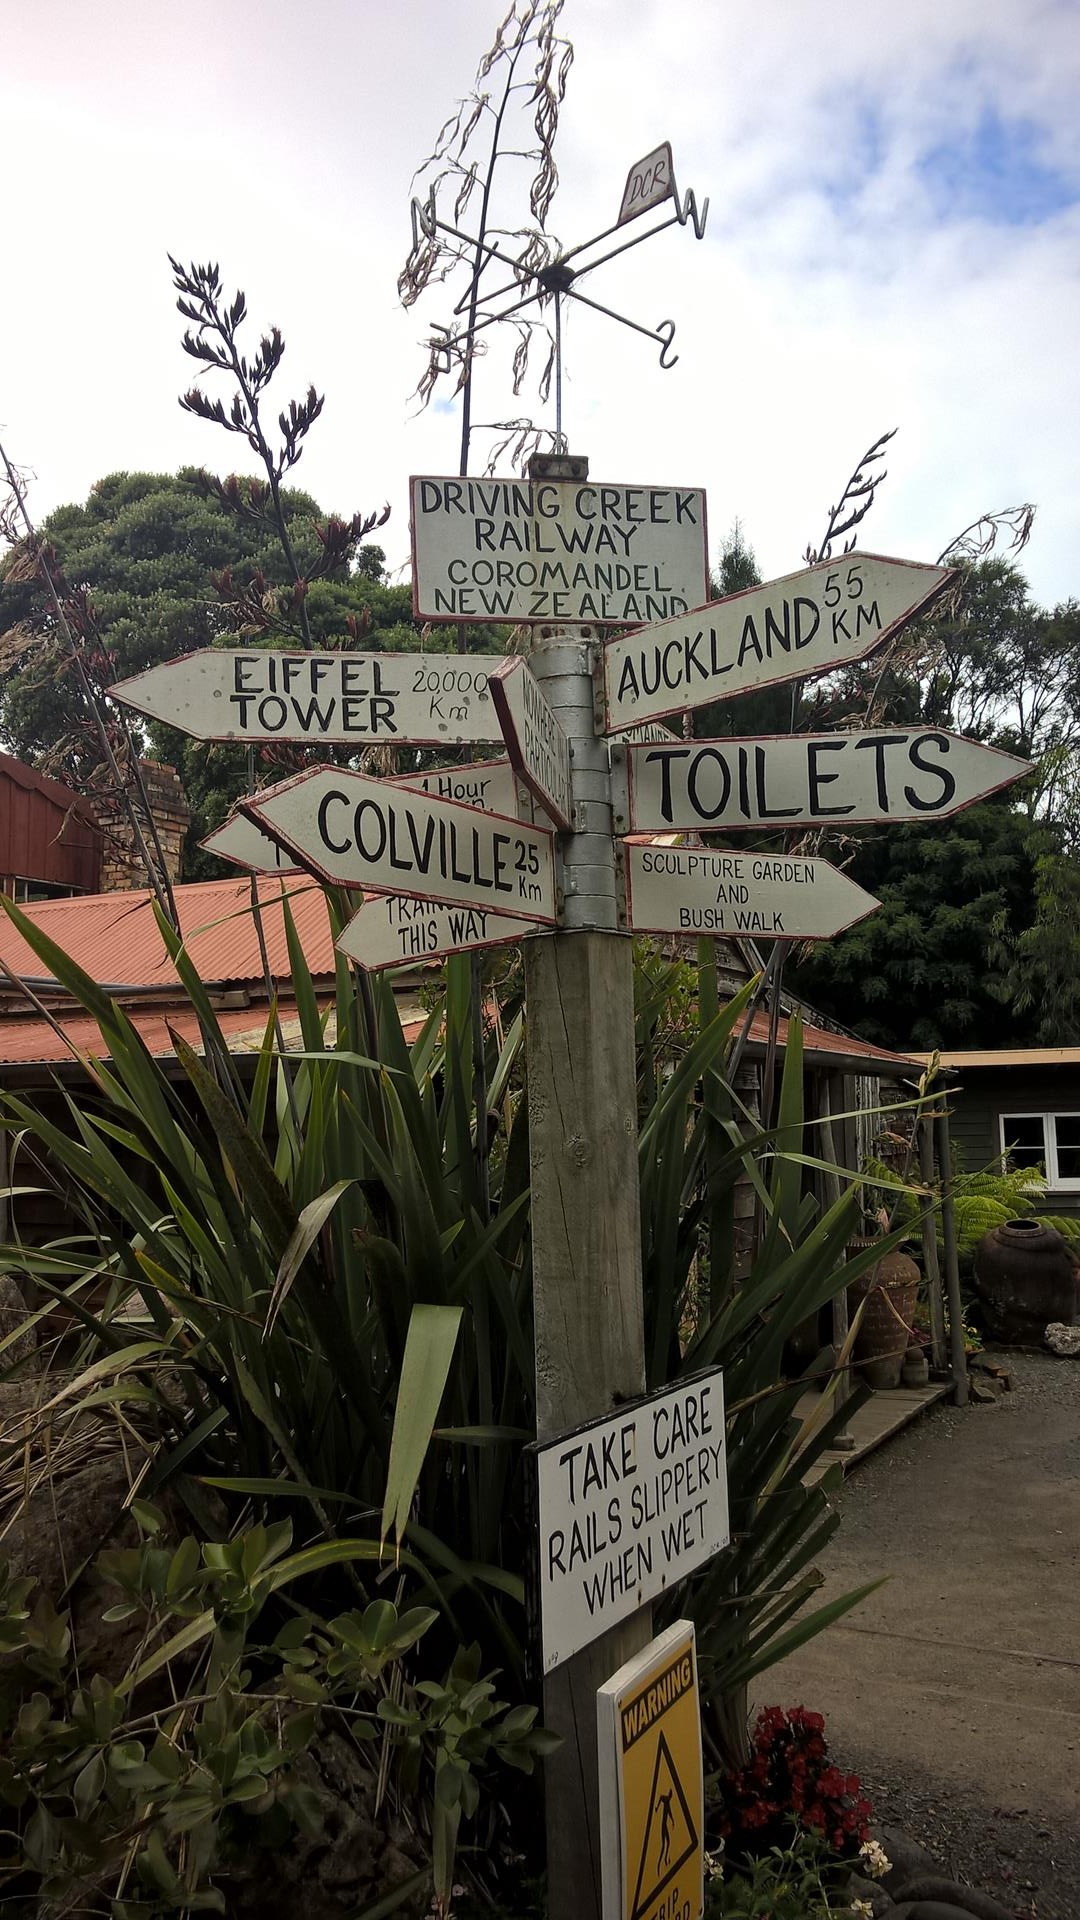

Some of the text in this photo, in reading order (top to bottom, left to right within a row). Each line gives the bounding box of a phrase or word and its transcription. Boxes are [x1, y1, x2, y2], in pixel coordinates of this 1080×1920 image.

[628, 161, 666, 206] DCR
[421, 480, 697, 524] DRIVING CREEK
[475, 518, 637, 557] RAILWAY
[448, 559, 672, 592] COROMANDEL
[824, 566, 863, 607] 55
[435, 588, 688, 621] NEW ZEALAND
[832, 600, 883, 644] KM
[617, 597, 820, 703] AUCKLAND
[234, 656, 400, 696] EIFFEL
[412, 671, 488, 694] 20,000
[230, 695, 398, 733] TOWER
[422, 776, 491, 800] 1 Hour
[646, 732, 955, 824] TOILETS
[317, 790, 513, 892] COLVILLE
[514, 839, 539, 875] 25
[642, 853, 815, 883] SCULPTURE GARDEN
[519, 875, 542, 902] Km
[716, 884, 749, 904] AND
[386, 896, 453, 925] TRAI
[680, 908, 784, 932] BUSH WALK
[398, 910, 488, 955] THIS WAY
[559, 1387, 712, 1506] TAKE CARE
[549, 1440, 723, 1582] RAILS SLIPPERY
[583, 1499, 708, 1616] WHEN WET
[623, 1657, 691, 1743] WARNING
[650, 1887, 679, 1920] RIP
